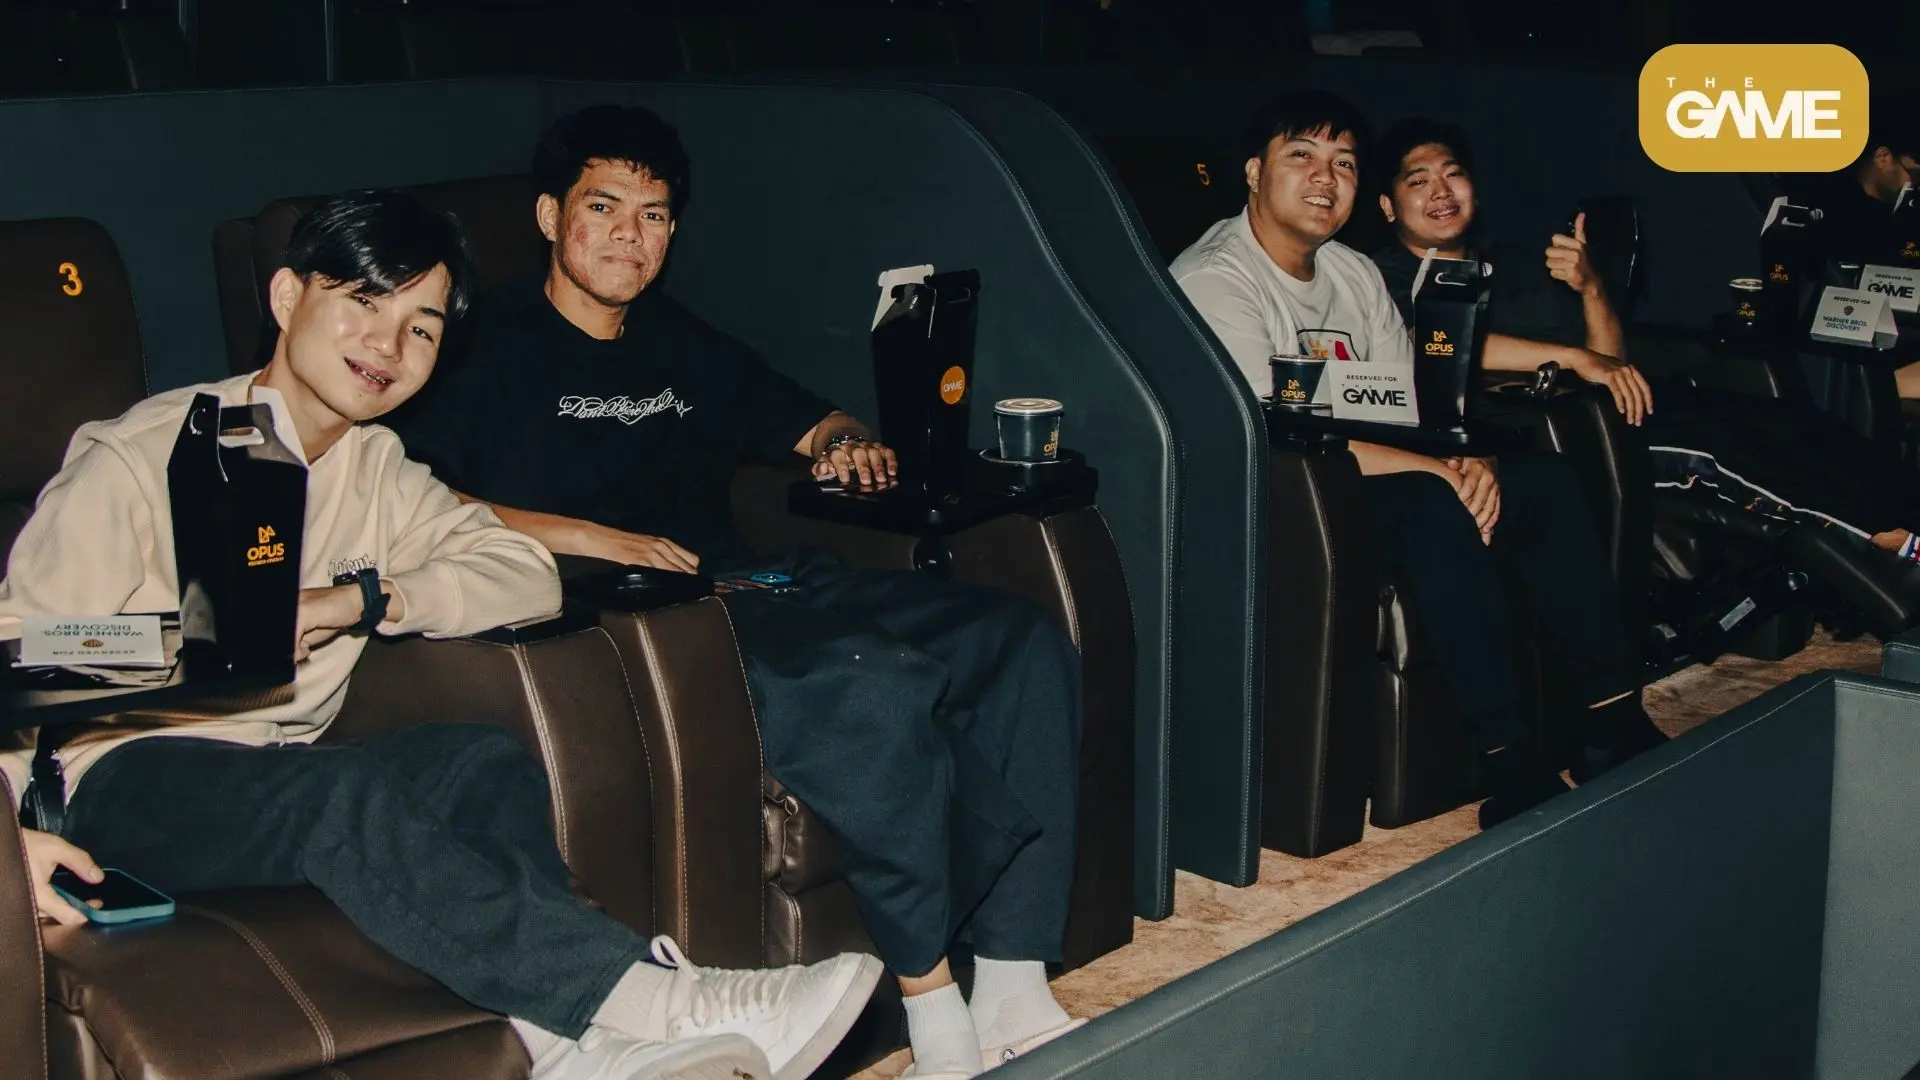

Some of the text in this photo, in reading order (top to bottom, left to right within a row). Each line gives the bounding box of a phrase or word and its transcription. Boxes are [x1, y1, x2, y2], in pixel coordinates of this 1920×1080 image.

[1196, 163, 1210, 186] 5
[59, 262, 83, 296] 3
[1867, 282, 1915, 299] GAME
[1823, 315, 1849, 324] WARNER
[1826, 322, 1861, 331] DISCOVERY
[1425, 342, 1454, 353] OPUS
[1281, 389, 1306, 399] OPUS
[1343, 388, 1408, 407] GAME
[246, 542, 285, 561] OPUS
